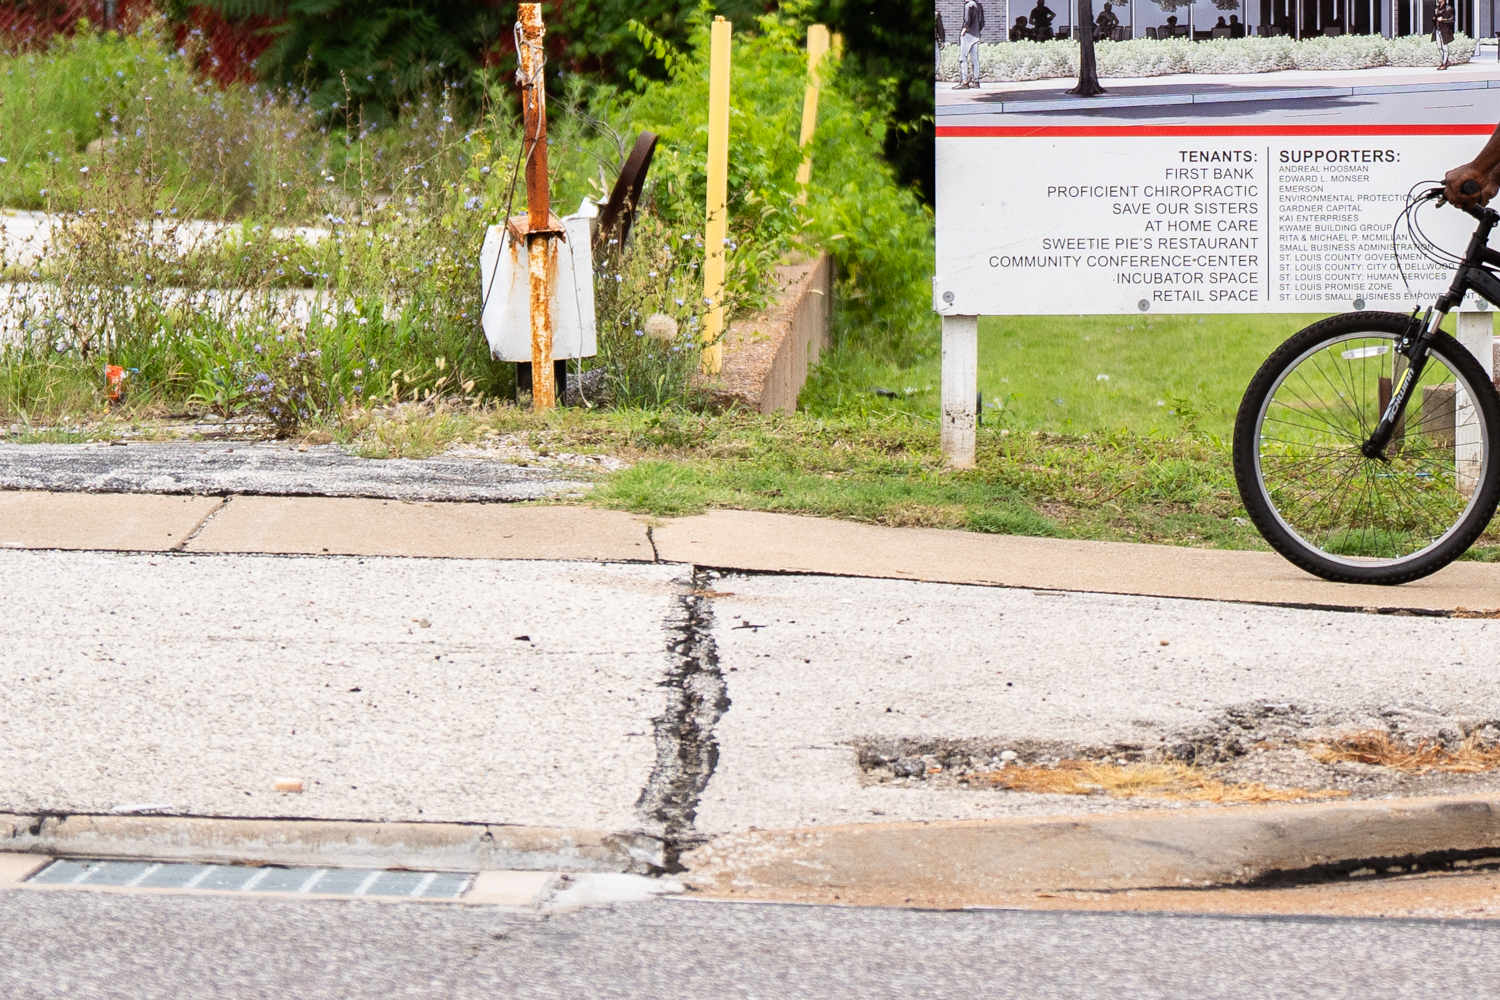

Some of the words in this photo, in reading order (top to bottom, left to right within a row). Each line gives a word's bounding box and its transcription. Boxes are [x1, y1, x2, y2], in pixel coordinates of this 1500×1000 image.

[1178, 149, 1258, 163] TENANTS:
[1279, 149, 1401, 163] SUPPORTERS:
[1278, 164, 1321, 173] ANDREAL
[1323, 164, 1369, 173] HOOSMAN
[1165, 167, 1209, 180] FIRST
[1213, 167, 1255, 180] BANK
[1278, 174, 1318, 183] EDWARD
[1320, 174, 1328, 183] L.
[1330, 174, 1370, 183] MONSER
[1047, 184, 1140, 198] PROFICIENT
[1143, 184, 1259, 198] CHIROPRACTIC
[1278, 184, 1324, 193] EMERSON
[1279, 194, 1355, 203] ENVIRONMENTAL
[1357, 194, 1416, 203] PROTECTION
[1112, 202, 1151, 215] SAVE
[1155, 202, 1190, 215] OUR
[1193, 202, 1259, 215] SISTERS
[1278, 204, 1323, 213] GARDNER
[1326, 204, 1363, 213] CAPITAL
[1279, 214, 1294, 223] KAI
[1296, 214, 1359, 223] ENTERPRISES
[1144, 219, 1163, 233] AT
[1167, 219, 1212, 233] HOME
[1216, 219, 1259, 233] CARE
[1279, 224, 1312, 232] KWAME
[1314, 224, 1357, 232] BUILDING
[1359, 224, 1393, 232] GROUP
[1279, 233, 1299, 242] RITA
[1301, 233, 1307, 242] &
[1309, 233, 1349, 242] MICHAEL
[1351, 233, 1359, 242] P.
[1361, 233, 1408, 242] MCMILLAN
[1042, 237, 1110, 250] SWEETIE
[1115, 237, 1153, 250] PIE'S
[1158, 237, 1260, 250] RESTAURANT
[1279, 243, 1308, 252] SMALL
[1310, 243, 1356, 252] BUSINESS
[1357, 243, 1434, 252] ADMINISTRATION
[988, 254, 1082, 268] COMMUNITY
[1279, 253, 1292, 262] ST.
[1294, 253, 1322, 262] LOUIS
[1324, 253, 1362, 262] COUNTY
[1364, 253, 1428, 262] GOVERNMENT
[1279, 263, 1292, 272] ST.
[1294, 263, 1322, 272] LOUIS
[1324, 263, 1364, 272] COUNTY:
[1366, 263, 1387, 272] CITY
[1389, 263, 1401, 272] OF
[1404, 263, 1455, 272] DELLWOOD
[1116, 271, 1204, 285] INCUBATOR
[1208, 271, 1259, 285] SPACE
[1279, 273, 1292, 282] ST.
[1294, 273, 1322, 282] LOUIS
[1324, 273, 1364, 282] COUNTY:
[1366, 273, 1399, 282] HUMAN
[1401, 273, 1447, 282] SERVICES
[1279, 283, 1292, 292] ST.
[1294, 283, 1322, 292] LOUIS
[1324, 283, 1366, 292] PROMISE
[1367, 283, 1393, 292] ZONE
[1152, 289, 1205, 302] RETAIL
[1208, 289, 1259, 302] SPACE
[1279, 292, 1292, 301] ST.
[1294, 292, 1322, 301] LOUIS
[1324, 292, 1354, 301] SMALL
[1355, 292, 1401, 301] BUSINESS
